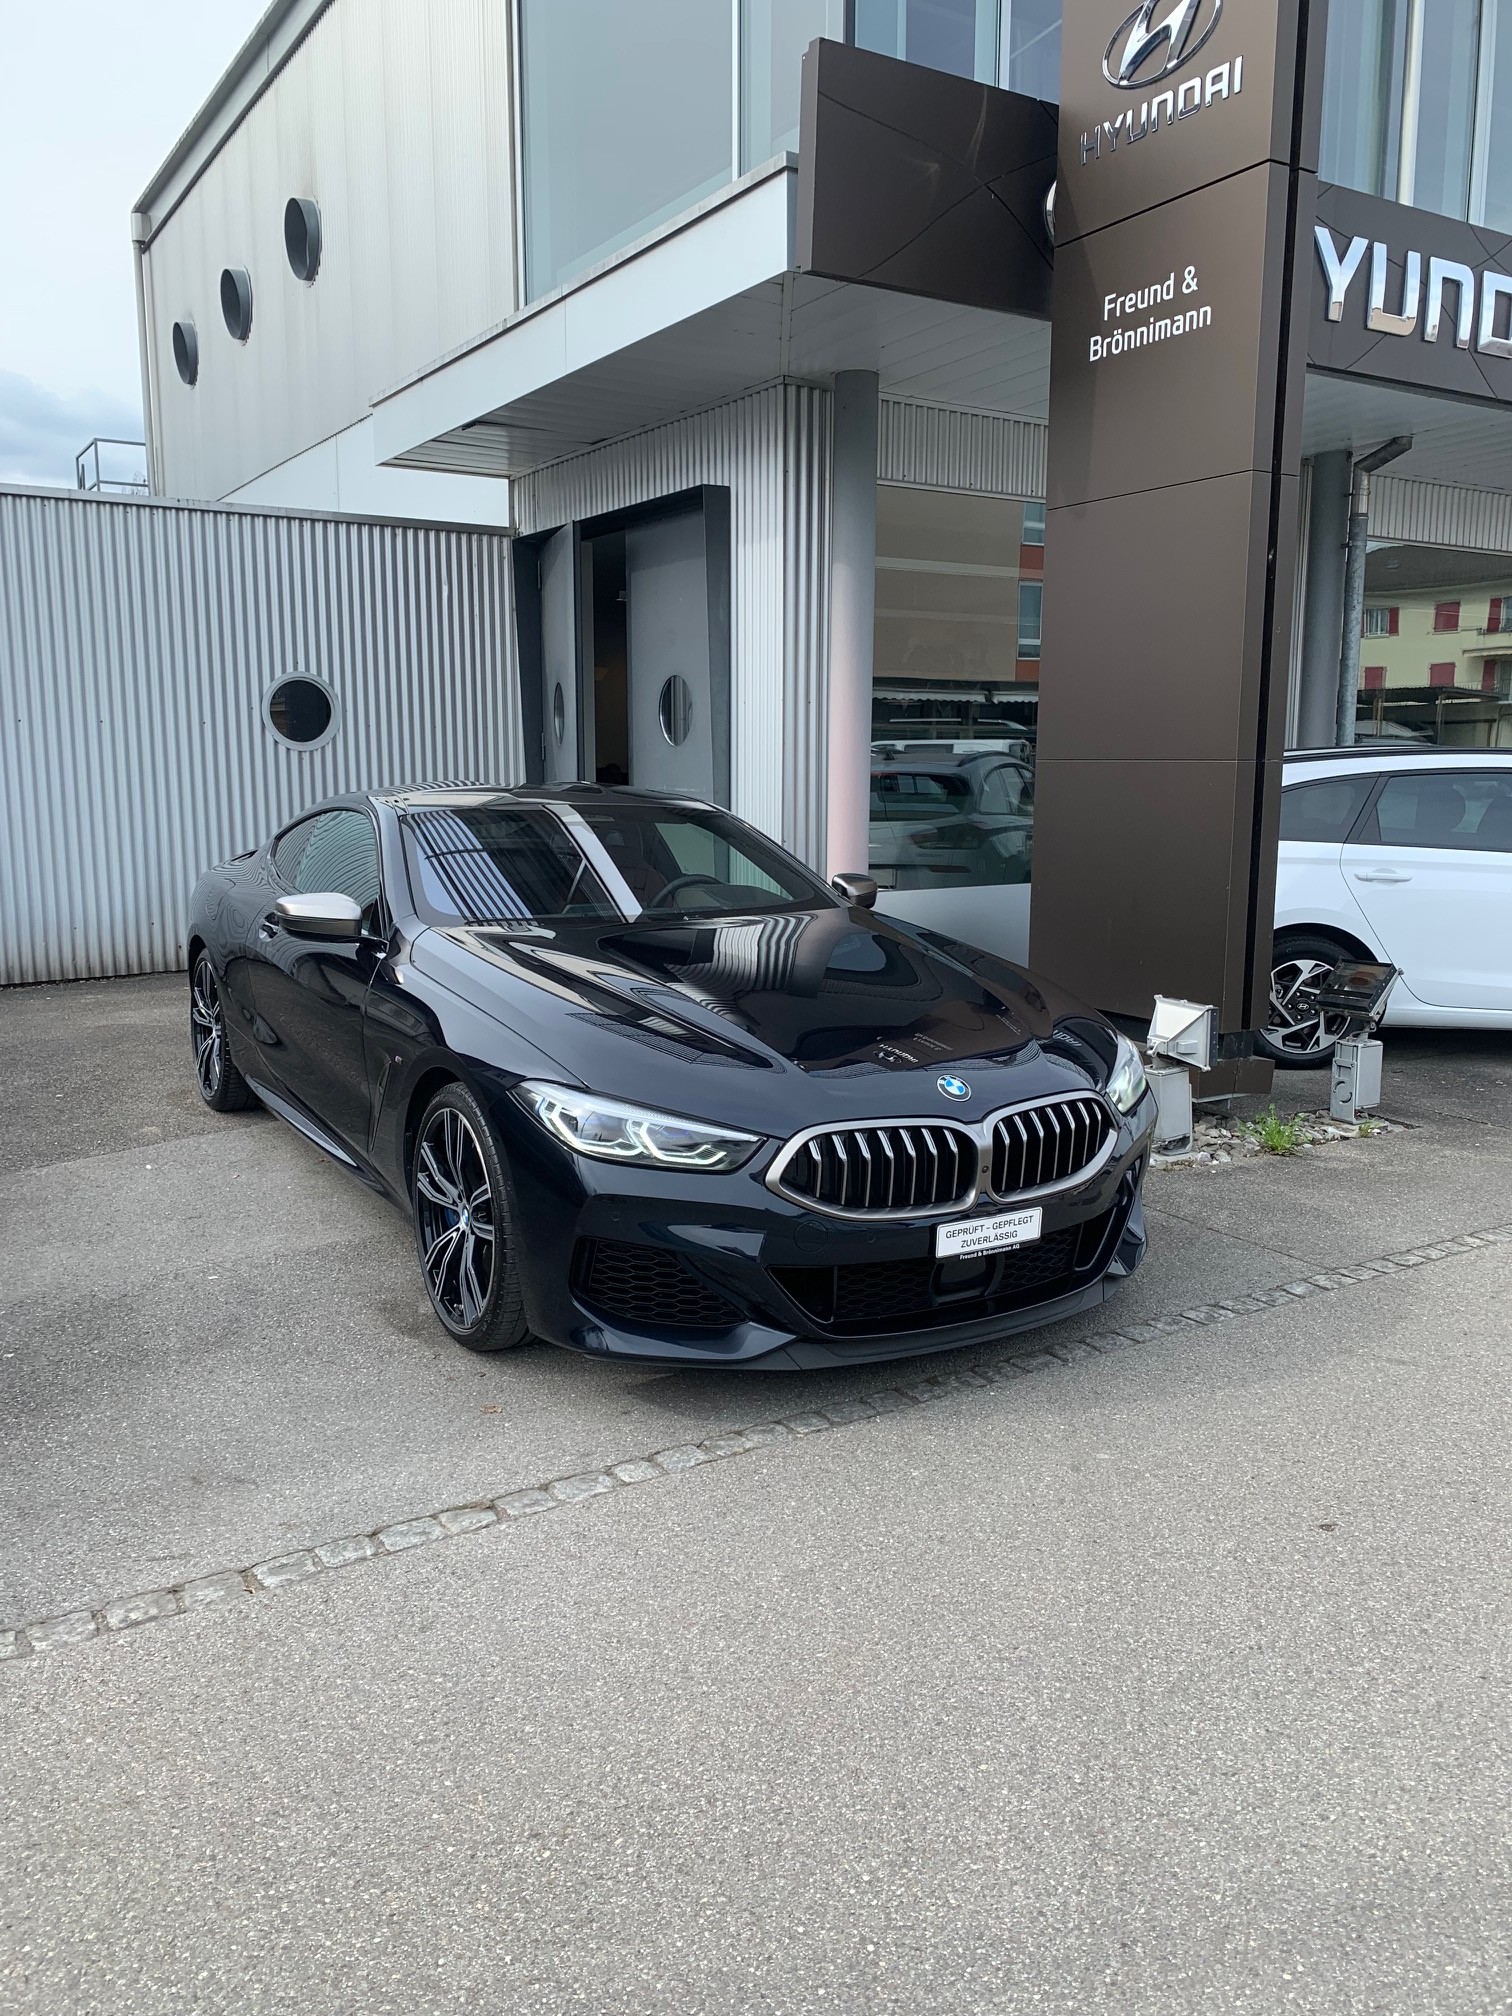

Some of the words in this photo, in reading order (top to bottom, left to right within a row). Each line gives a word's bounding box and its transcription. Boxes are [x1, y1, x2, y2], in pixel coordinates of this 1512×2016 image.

[1080, 55, 1243, 165] HYUNDAI
[1103, 272, 1174, 321] Freund
[1181, 265, 1198, 293] &
[1089, 305, 1211, 362] Brönnimann
[945, 1224, 985, 1239] GEPRÜFT
[992, 1215, 1034, 1230] GEPFLEGT
[961, 1230, 1018, 1248] ZUVERLÄSSIG
[959, 1252, 977, 1260] Freund
[982, 1246, 1012, 1256] Brönnimann
